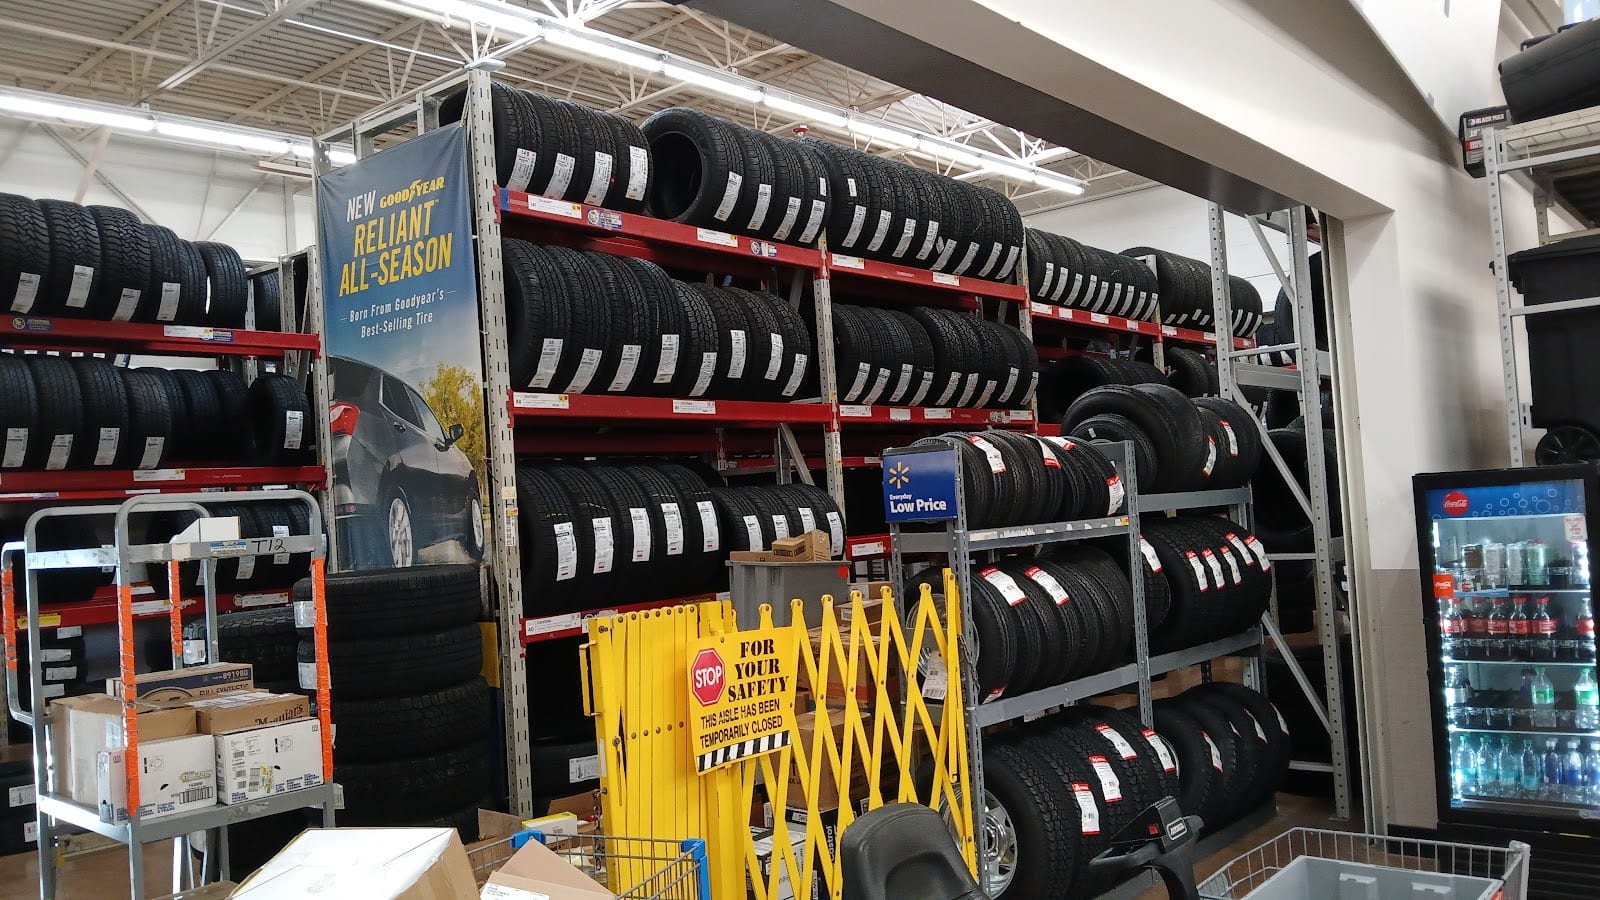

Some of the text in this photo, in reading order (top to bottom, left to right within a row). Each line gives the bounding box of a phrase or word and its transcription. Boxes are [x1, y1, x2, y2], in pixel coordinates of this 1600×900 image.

[346, 176, 446, 222] NEW GOODYEAR
[353, 201, 435, 257] RELIANT
[338, 232, 453, 296] ALL-SEASON
[350, 287, 444, 323] Born From Goodyear's
[361, 311, 433, 338] Best-Selling Tire
[889, 493, 912, 501] Everyday
[889, 498, 947, 513] Low Price
[739, 638, 775, 659] FOR
[695, 665, 722, 689] STOP
[734, 658, 780, 680] YOUR
[728, 676, 789, 703] SAFETY
[701, 698, 780, 730] THIS AISLE HAS BEEN
[700, 715, 783, 749] TEMPORARILY CLOSED
